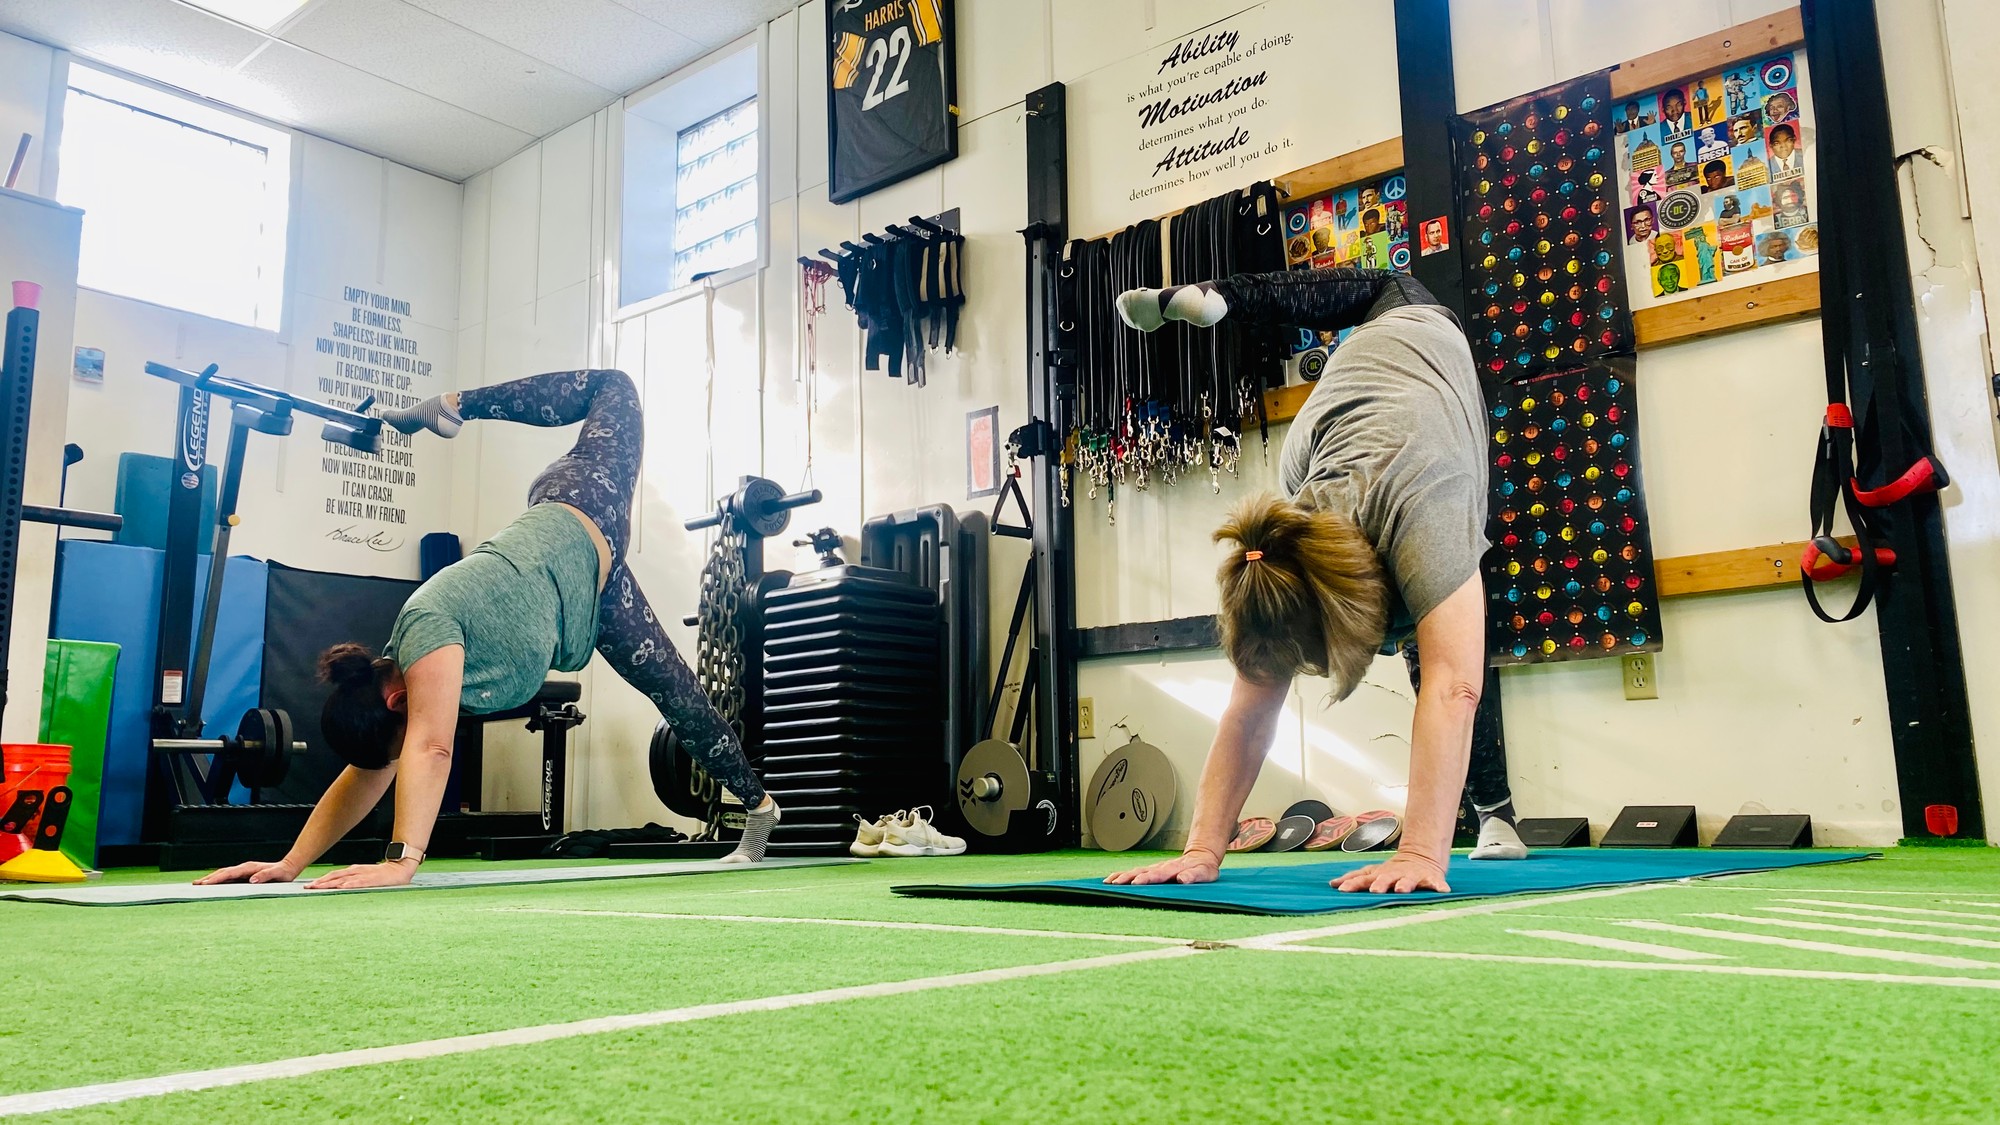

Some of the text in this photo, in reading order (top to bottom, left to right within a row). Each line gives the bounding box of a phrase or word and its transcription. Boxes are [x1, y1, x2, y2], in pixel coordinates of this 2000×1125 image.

[864, 0, 905, 32] HARRIS
[1126, 32, 1294, 103] is what you're capable of doing.
[1157, 30, 1241, 75] Ability
[862, 26, 912, 112] 22
[1138, 70, 1269, 130] Motivation
[1138, 96, 1268, 151] determines what you do.
[1665, 130, 1690, 142] DREAM
[1152, 126, 1250, 178] Attitude
[1698, 146, 1730, 164] FRESH
[1128, 138, 1294, 202] determines how well you do it.
[1774, 168, 1802, 180] DREAM
[344, 286, 370, 306] EMPTY
[370, 292, 390, 312] YOUR
[352, 307, 362, 322] BE
[332, 322, 392, 350] SHAPELESS-LIKE
[316, 337, 335, 354] NOW
[336, 342, 351, 358] YOU
[352, 346, 366, 364] PUT
[368, 350, 392, 368] WATER
[394, 356, 410, 372] INTO
[411, 359, 416, 374] A
[336, 361, 344, 376] IT
[345, 364, 380, 384] BECOMES
[381, 372, 395, 388] THE
[318, 376, 334, 394] YOU
[335, 379, 349, 398] PUT
[376, 389, 393, 407] INTO
[394, 393, 400, 409] A
[188, 388, 202, 460] LEGEND
[322, 457, 416, 488] NOW WATER CAN FLOW OR
[342, 480, 350, 496] IT
[351, 482, 366, 499] CAN
[326, 498, 335, 514] BE
[366, 504, 378, 520] MY
[380, 506, 407, 525] FRIEND.
